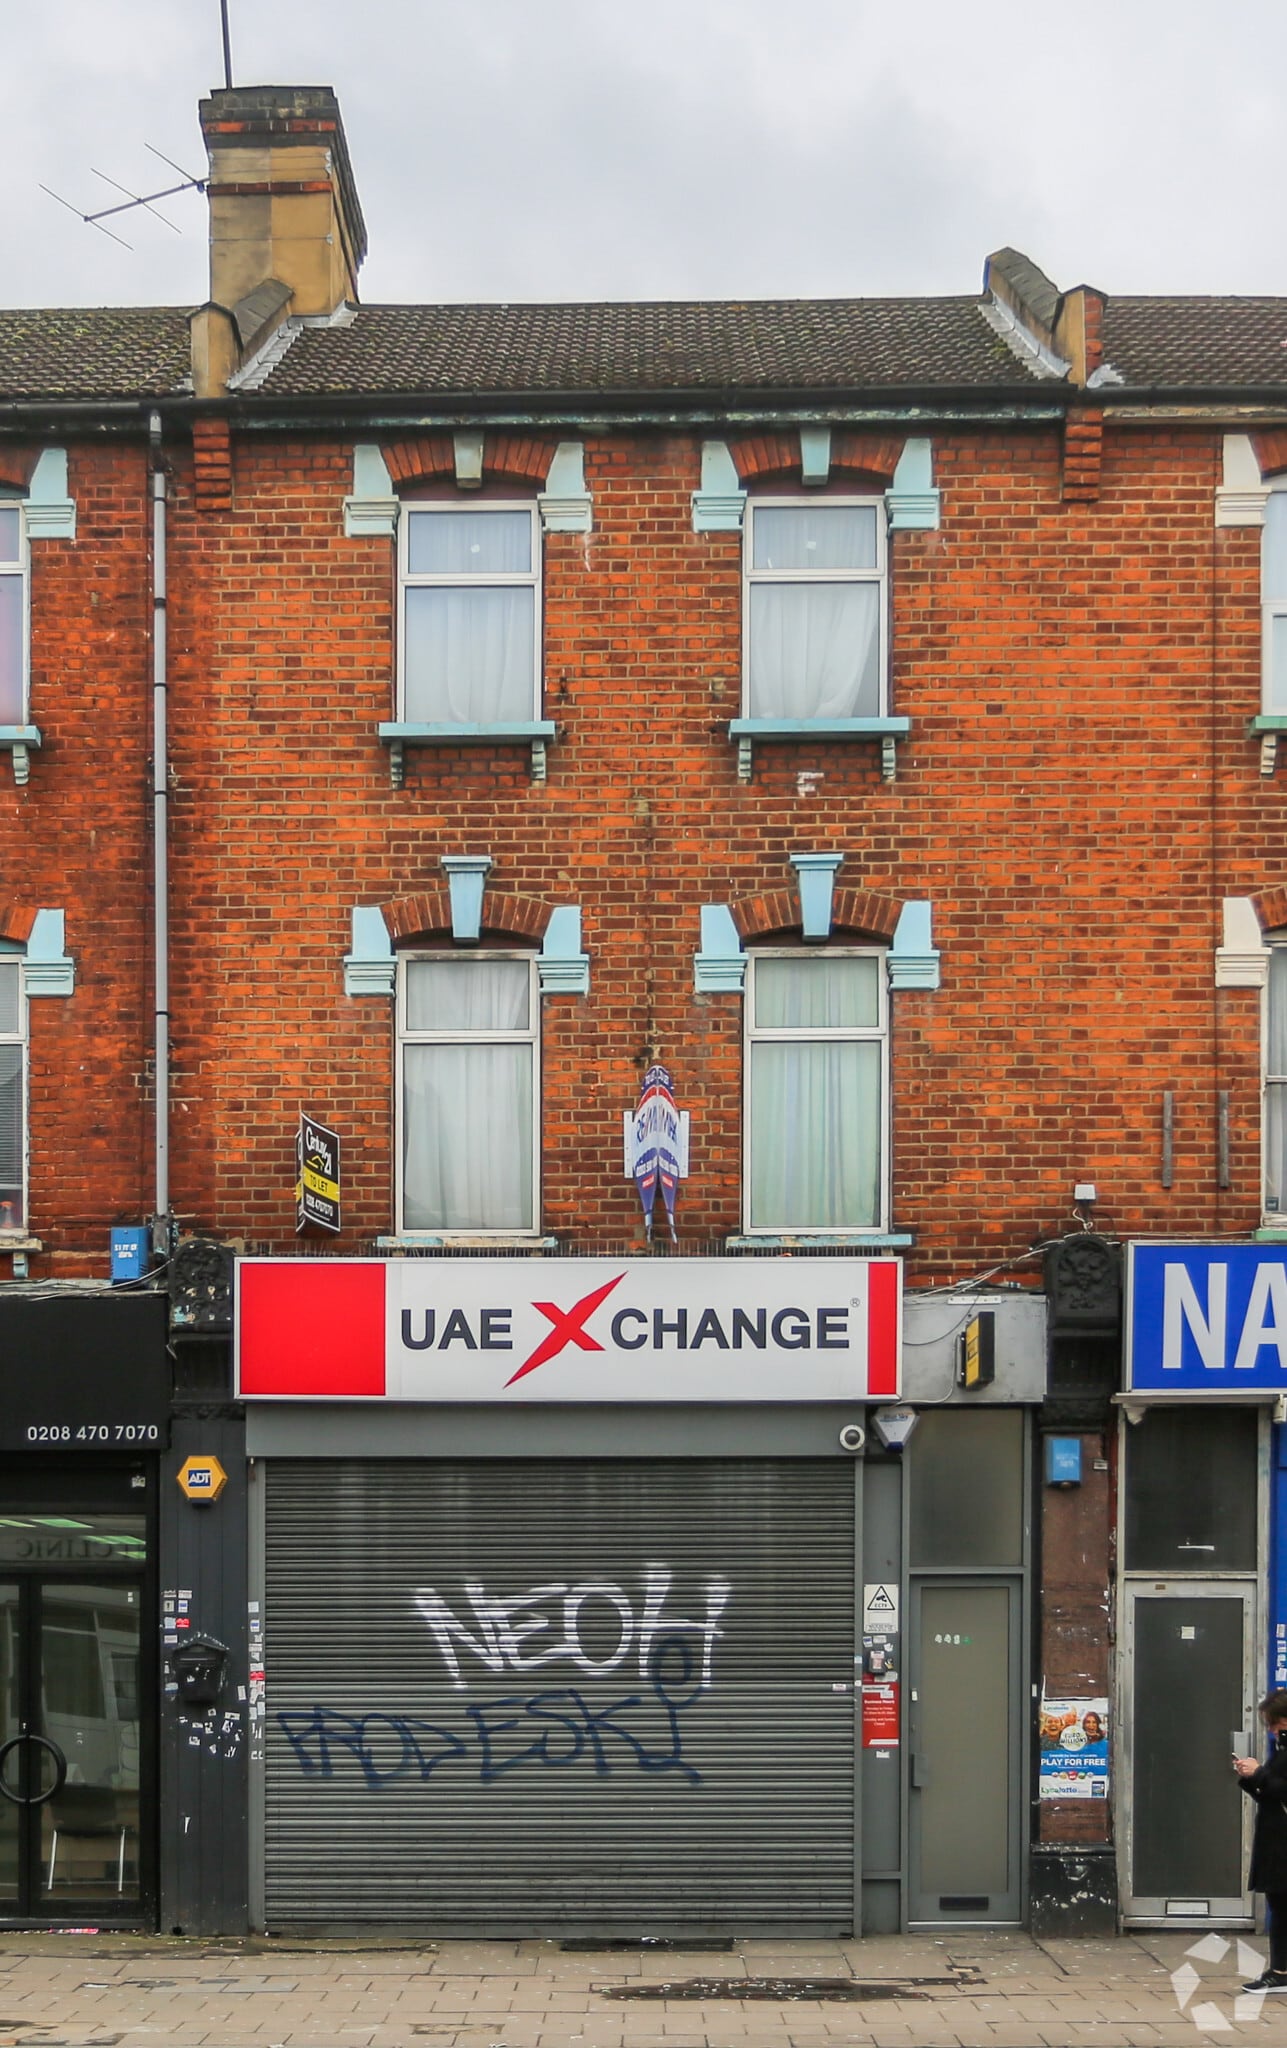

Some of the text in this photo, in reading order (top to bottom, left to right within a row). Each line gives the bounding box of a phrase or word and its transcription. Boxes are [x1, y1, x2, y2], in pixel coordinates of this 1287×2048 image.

[318, 1178, 328, 1193] LET
[400, 1308, 513, 1350] UAE
[27, 1425, 158, 1441] 0208 470 7070
[187, 1472, 211, 1485] ADT
[1041, 1758, 1106, 1766] PLAY FOR FREE
